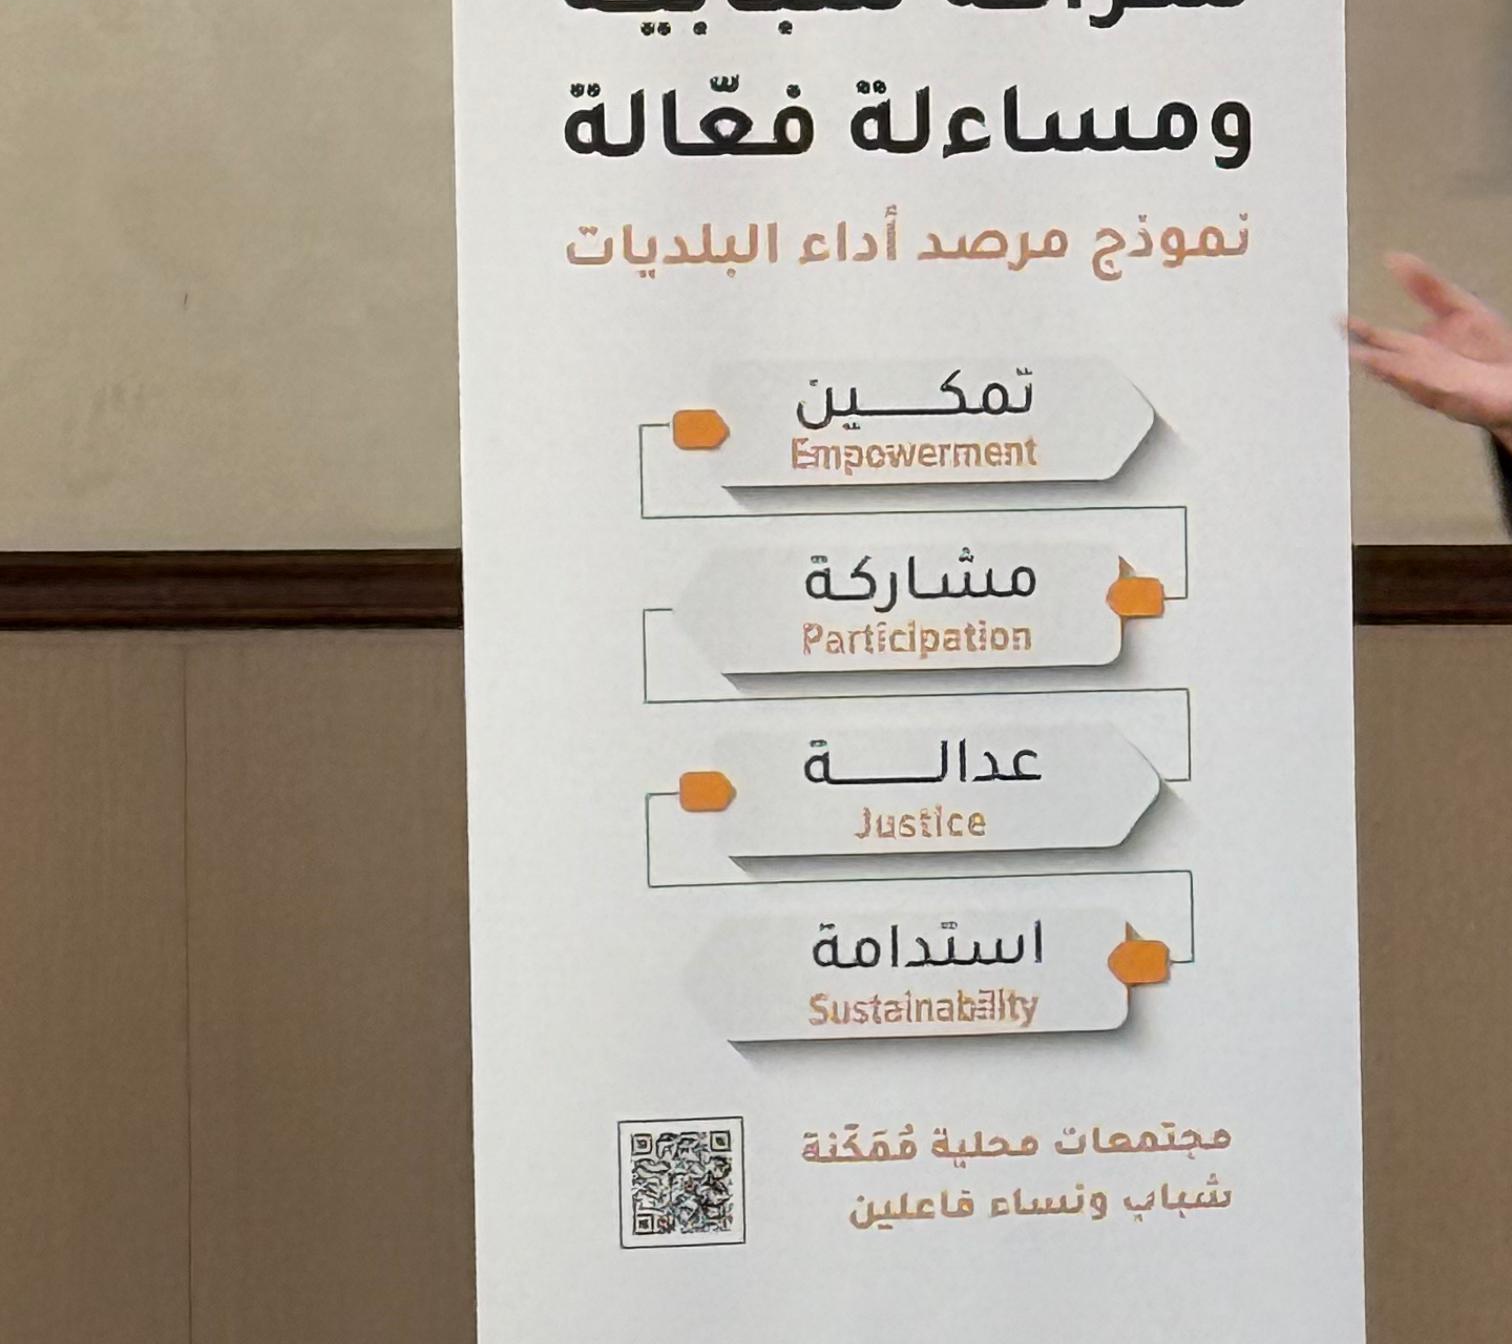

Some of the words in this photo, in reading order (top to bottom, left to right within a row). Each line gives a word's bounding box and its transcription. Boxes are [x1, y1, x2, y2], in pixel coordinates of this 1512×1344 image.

[563, 73, 815, 158] فعّالة
[850, 79, 1252, 170] ومساءلة
[566, 222, 778, 280] البلديات
[798, 204, 898, 266] أداء
[917, 228, 1069, 272] مرصد
[1091, 212, 1249, 282] نموذج
[796, 367, 1033, 431] تمكين
[791, 437, 1038, 475] Empowerment
[804, 546, 1037, 614] مشاركة
[802, 619, 1032, 660] Participation
[803, 737, 1043, 786] عدالة
[854, 805, 987, 840] Justice
[811, 918, 1043, 970] استدامة
[809, 989, 1039, 1028] Sustainability
[931, 1127, 1039, 1169] محلية
[1054, 1121, 1232, 1160] مجتمعات
[849, 1189, 975, 1230] فاعلين
[990, 1183, 1108, 1221] ونساء
[1124, 1172, 1233, 1223] شباب
